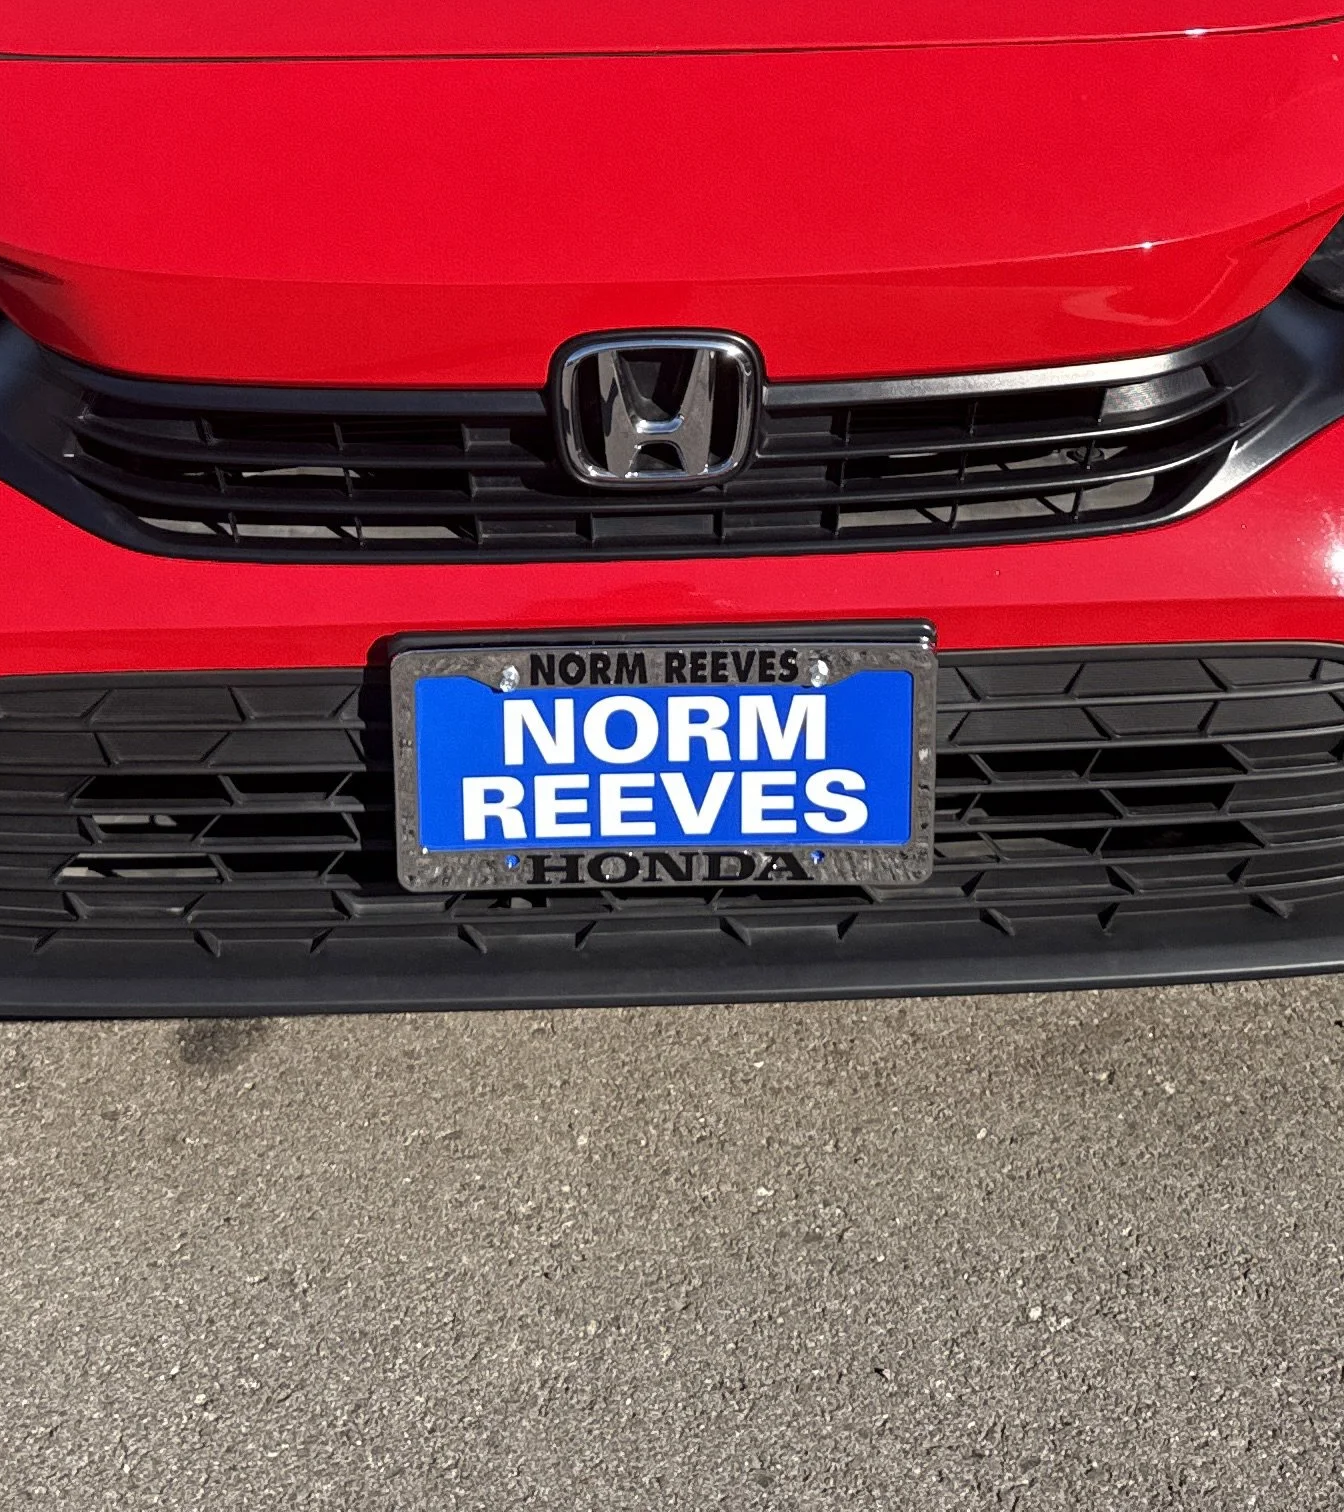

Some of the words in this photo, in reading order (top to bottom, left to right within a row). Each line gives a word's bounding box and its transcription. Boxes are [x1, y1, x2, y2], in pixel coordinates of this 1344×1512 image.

[529, 651, 649, 686] NORM
[664, 649, 800, 684] REEVES
[503, 694, 827, 766] NORM
[462, 768, 869, 841] REEVES
[526, 850, 815, 885] HONDA
